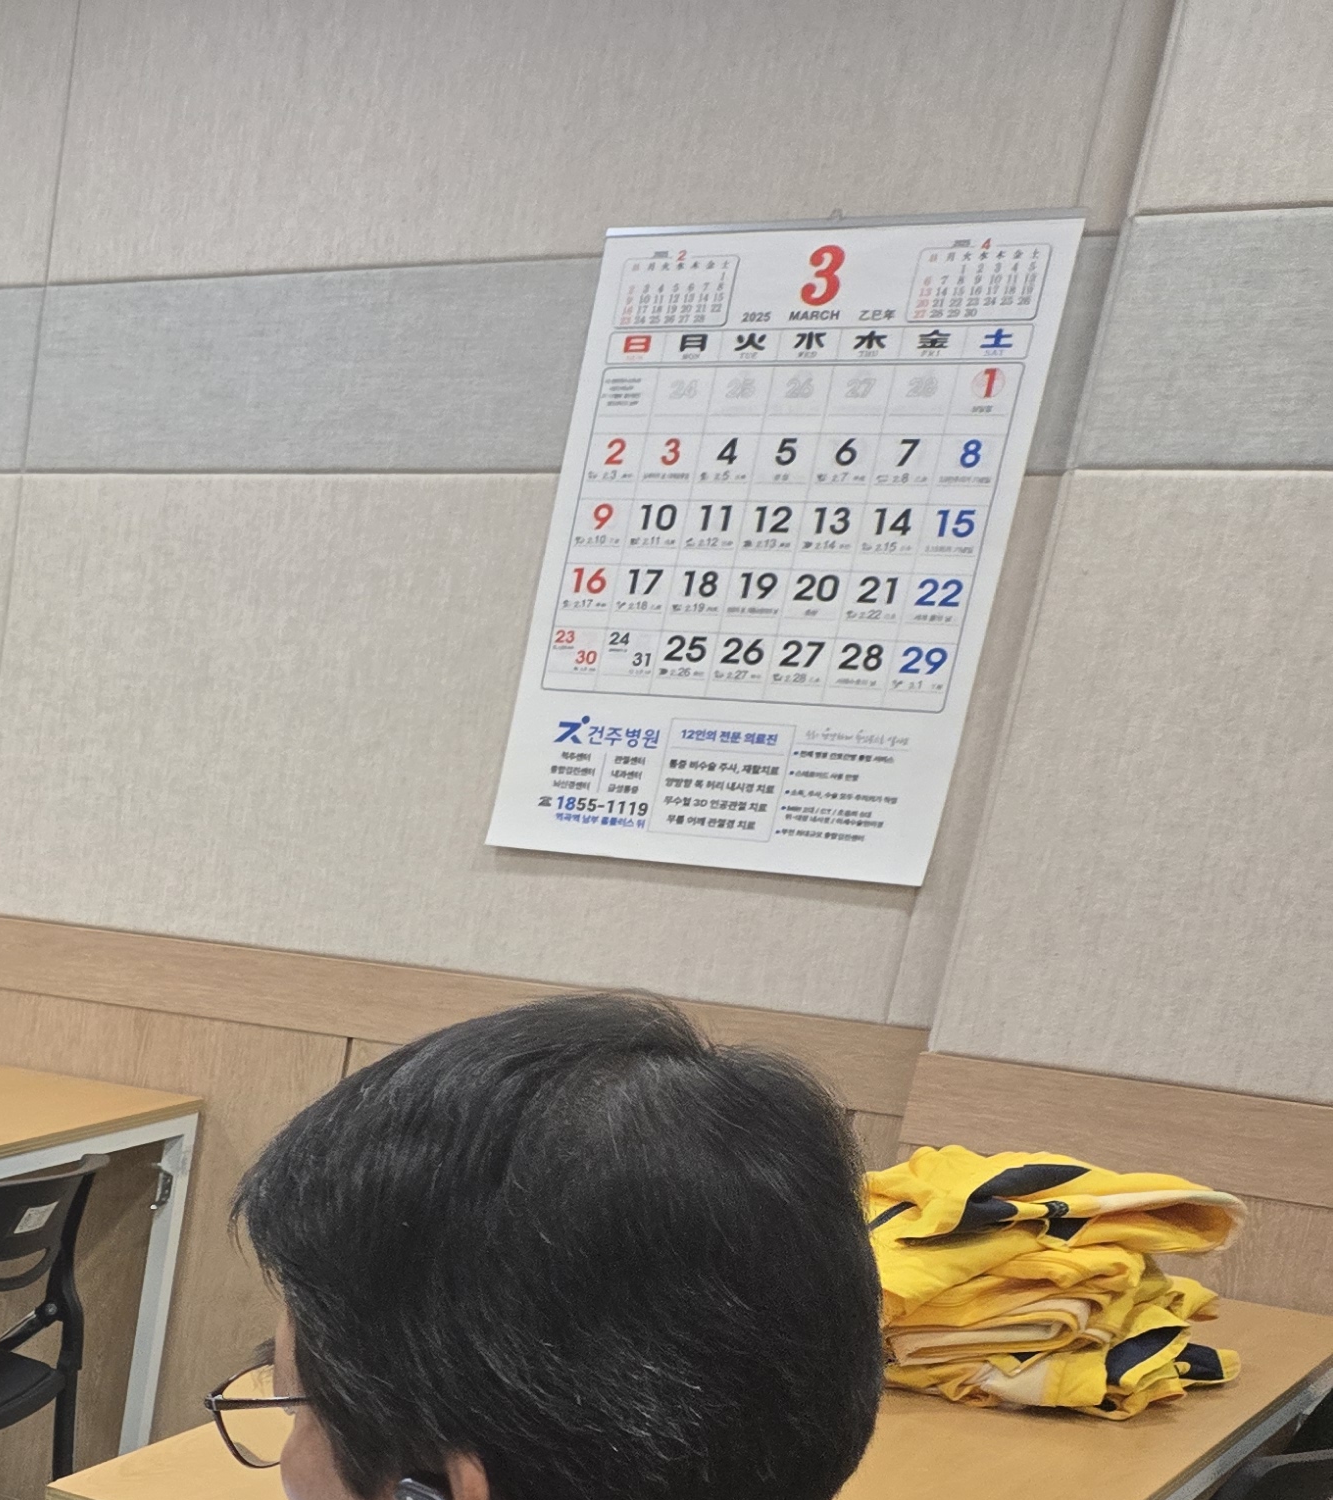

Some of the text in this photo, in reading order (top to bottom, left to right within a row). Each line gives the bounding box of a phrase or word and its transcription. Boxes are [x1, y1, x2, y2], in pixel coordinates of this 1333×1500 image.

[981, 237, 992, 250] 4
[800, 245, 846, 306] 3
[741, 309, 841, 323] 2025 MARCH
[623, 328, 1013, 353] 日 月 火 水 木 金 土
[983, 368, 997, 398] 1
[604, 437, 982, 468] 2 3 4 5 6 7 8
[593, 503, 976, 538] 9 10 11 12 13 14 15
[573, 567, 963, 607] 16 17 18 19 20 21 22
[554, 629, 948, 675] 23 24 25 26 27 28 29
[575, 650, 651, 667] 30 31
[588, 726, 661, 749] 건주병원
[681, 729, 778, 746] 12인의 전문 의료진
[689, 760, 717, 772] 비수술
[742, 764, 780, 776] 재활치료
[756, 784, 775, 794] 치료
[557, 795, 649, 817] 1855-1119
[748, 802, 768, 812] 치료
[737, 819, 756, 830] 치료
